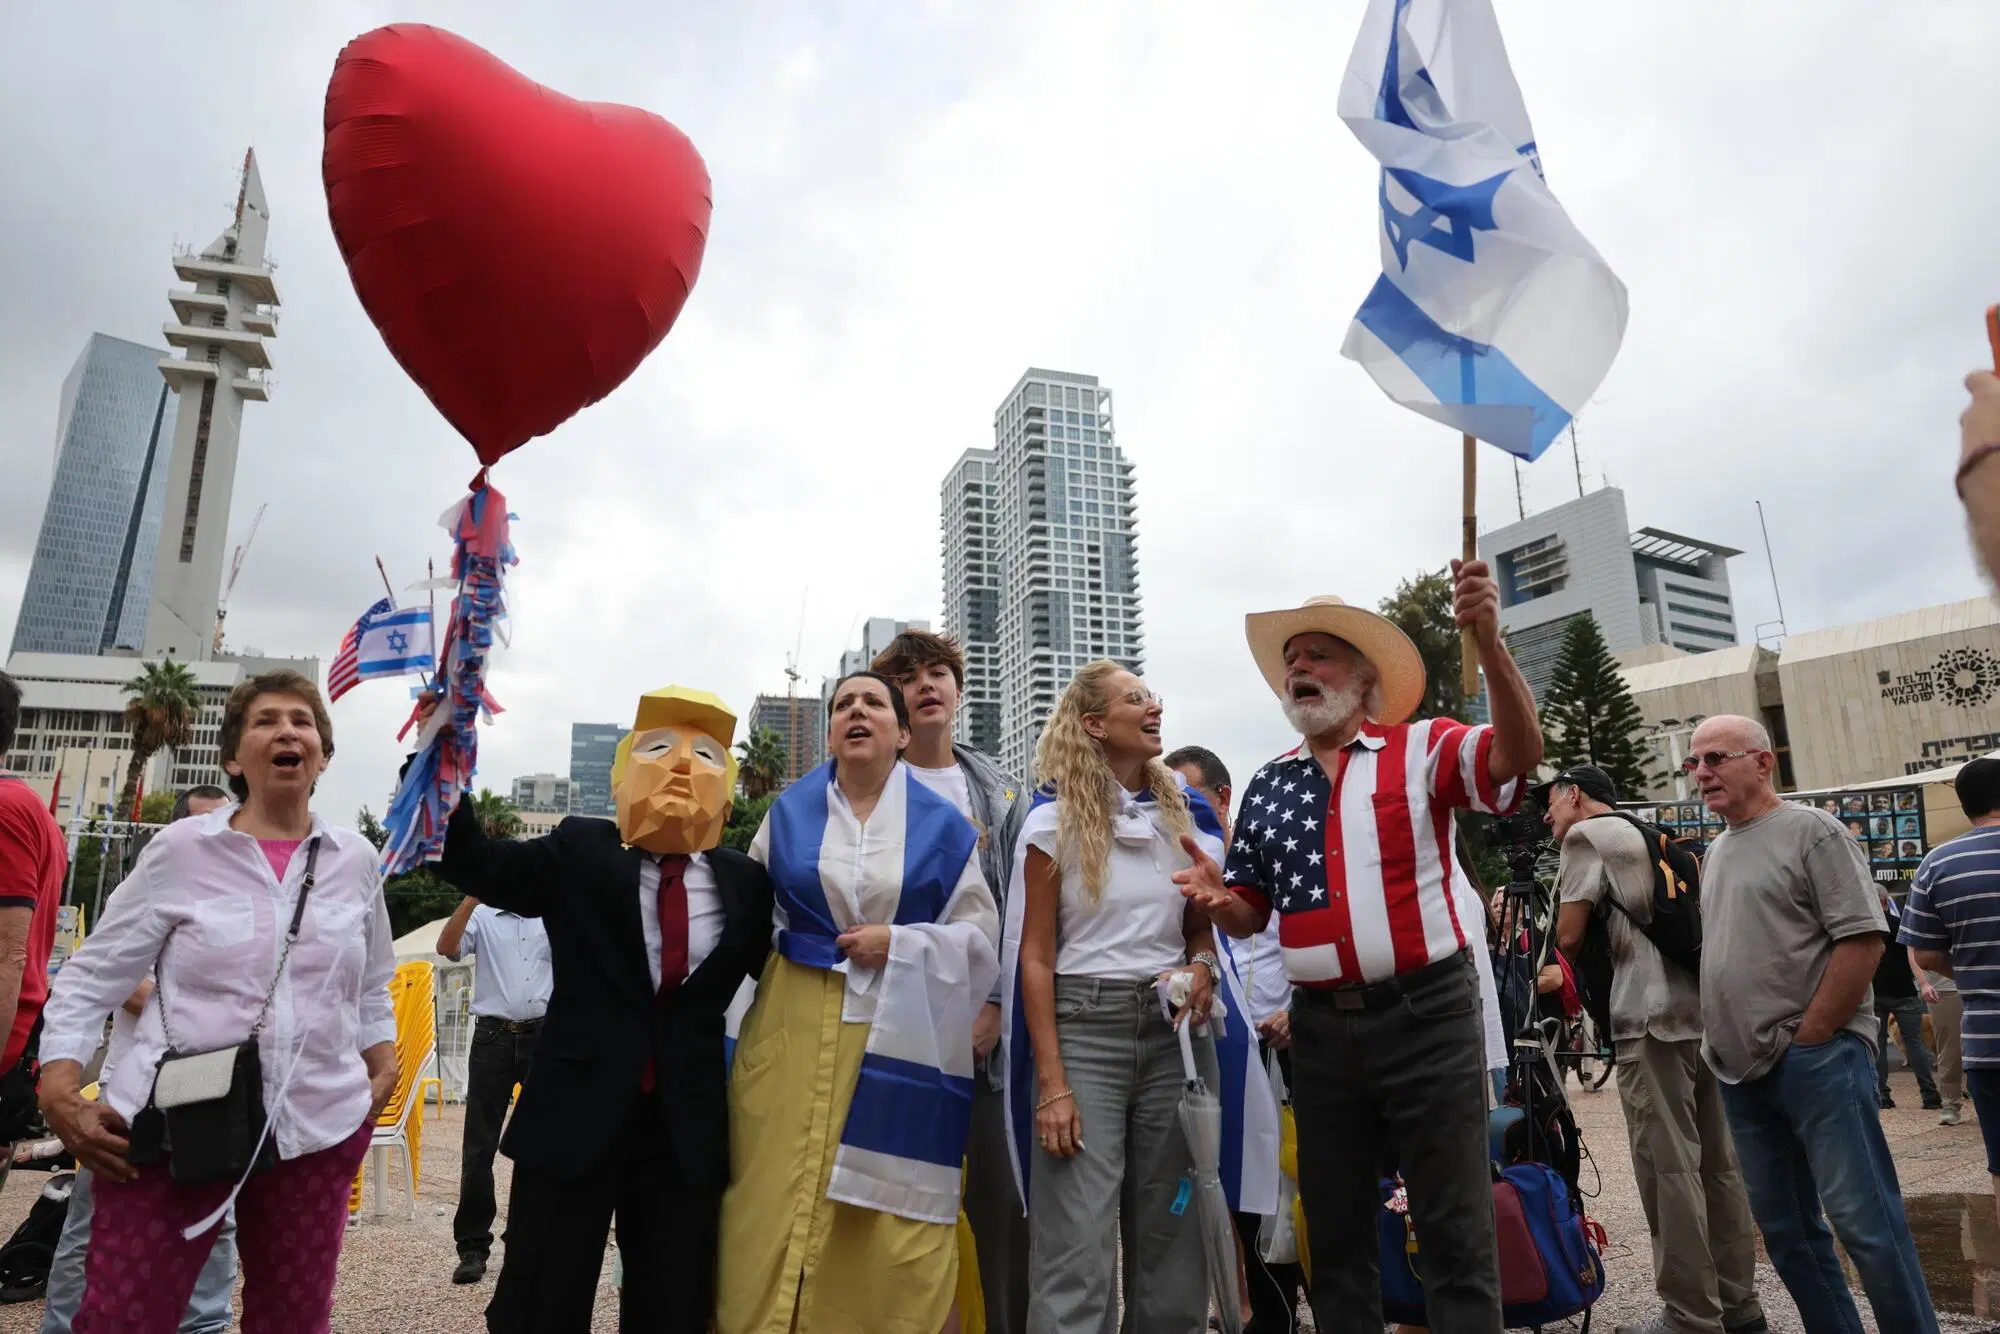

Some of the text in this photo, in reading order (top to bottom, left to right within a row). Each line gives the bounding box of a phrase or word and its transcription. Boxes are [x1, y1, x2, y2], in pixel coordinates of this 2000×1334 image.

[1896, 674, 1916, 685] TEL
[1915, 671, 1932, 682] תל
[1881, 686, 1905, 698] AVIV
[1906, 681, 1933, 694] אביב
[1892, 693, 1919, 706] YAFO
[1919, 690, 1935, 702] יפו
